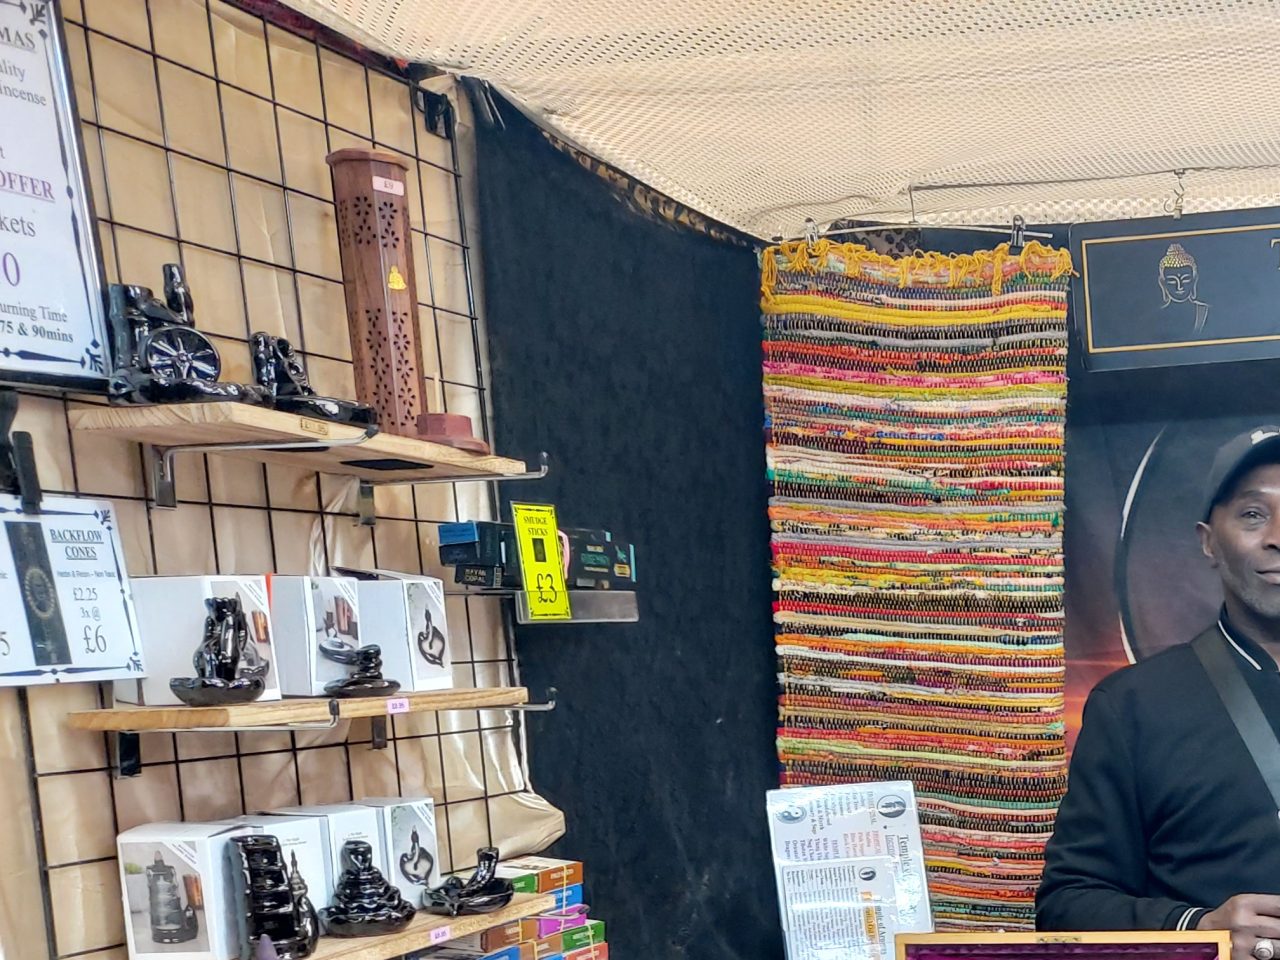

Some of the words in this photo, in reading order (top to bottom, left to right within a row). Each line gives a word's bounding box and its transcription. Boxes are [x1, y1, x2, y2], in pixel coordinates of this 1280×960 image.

[38, 306, 68, 323] Time
[17, 322, 29, 336] &
[32, 325, 74, 343] 90mins
[523, 515, 548, 525] SMUDGE
[50, 529, 102, 542] BACKFLOW
[528, 527, 548, 536] STICKS
[65, 546, 97, 558] CONES
[536, 573, 558, 604] £3
[80, 607, 91, 619] 3x
[83, 624, 107, 654] £6
